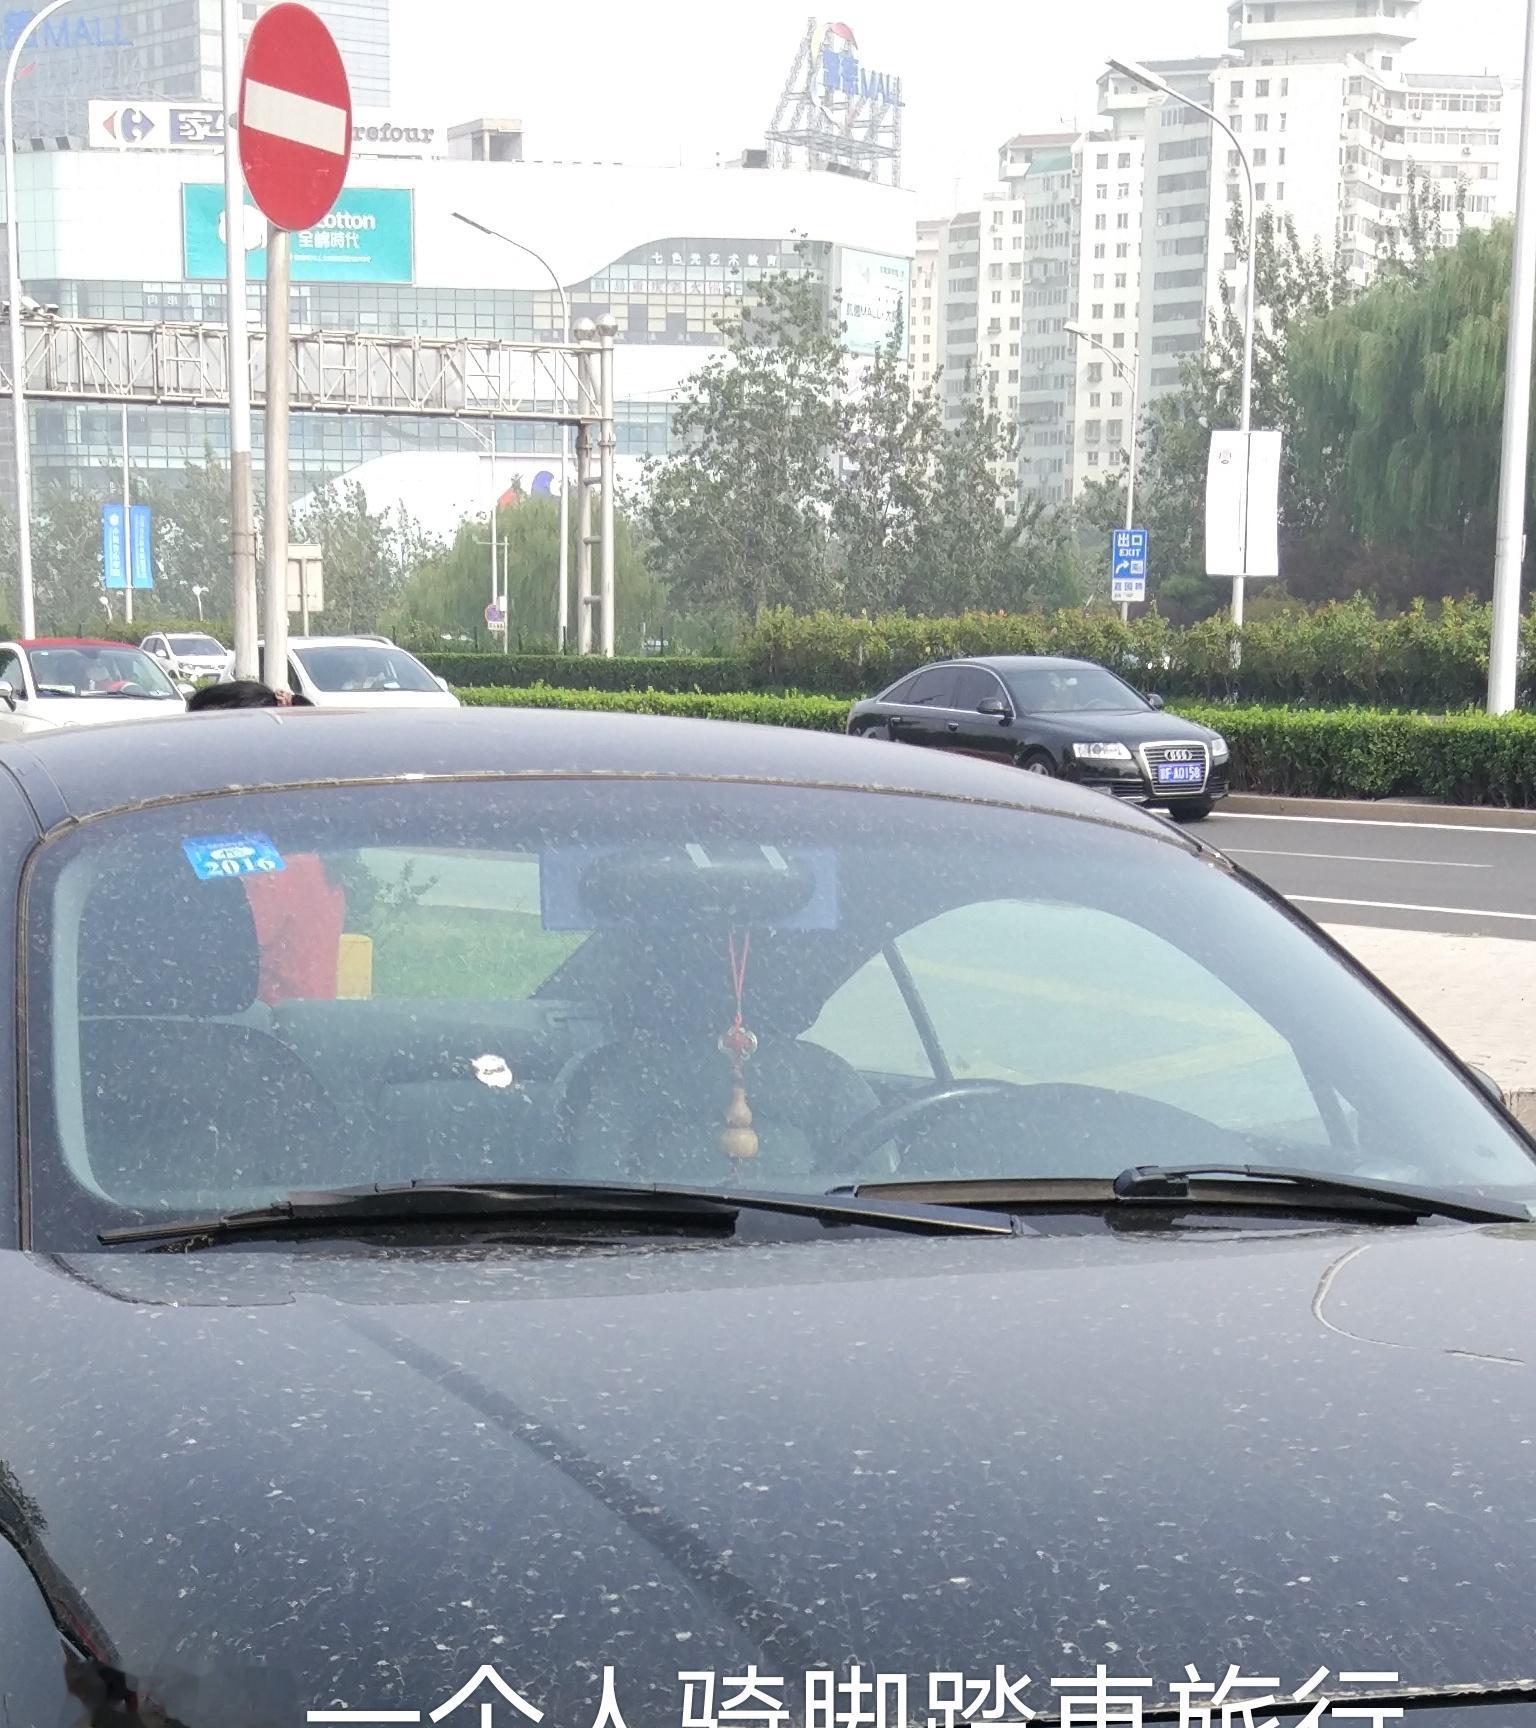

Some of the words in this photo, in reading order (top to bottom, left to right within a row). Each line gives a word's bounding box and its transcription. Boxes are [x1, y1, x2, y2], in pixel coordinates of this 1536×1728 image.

[1117, 533, 1143, 548] 出口
[1119, 548, 1142, 557] EXIT
[205, 858, 277, 878] 2016
